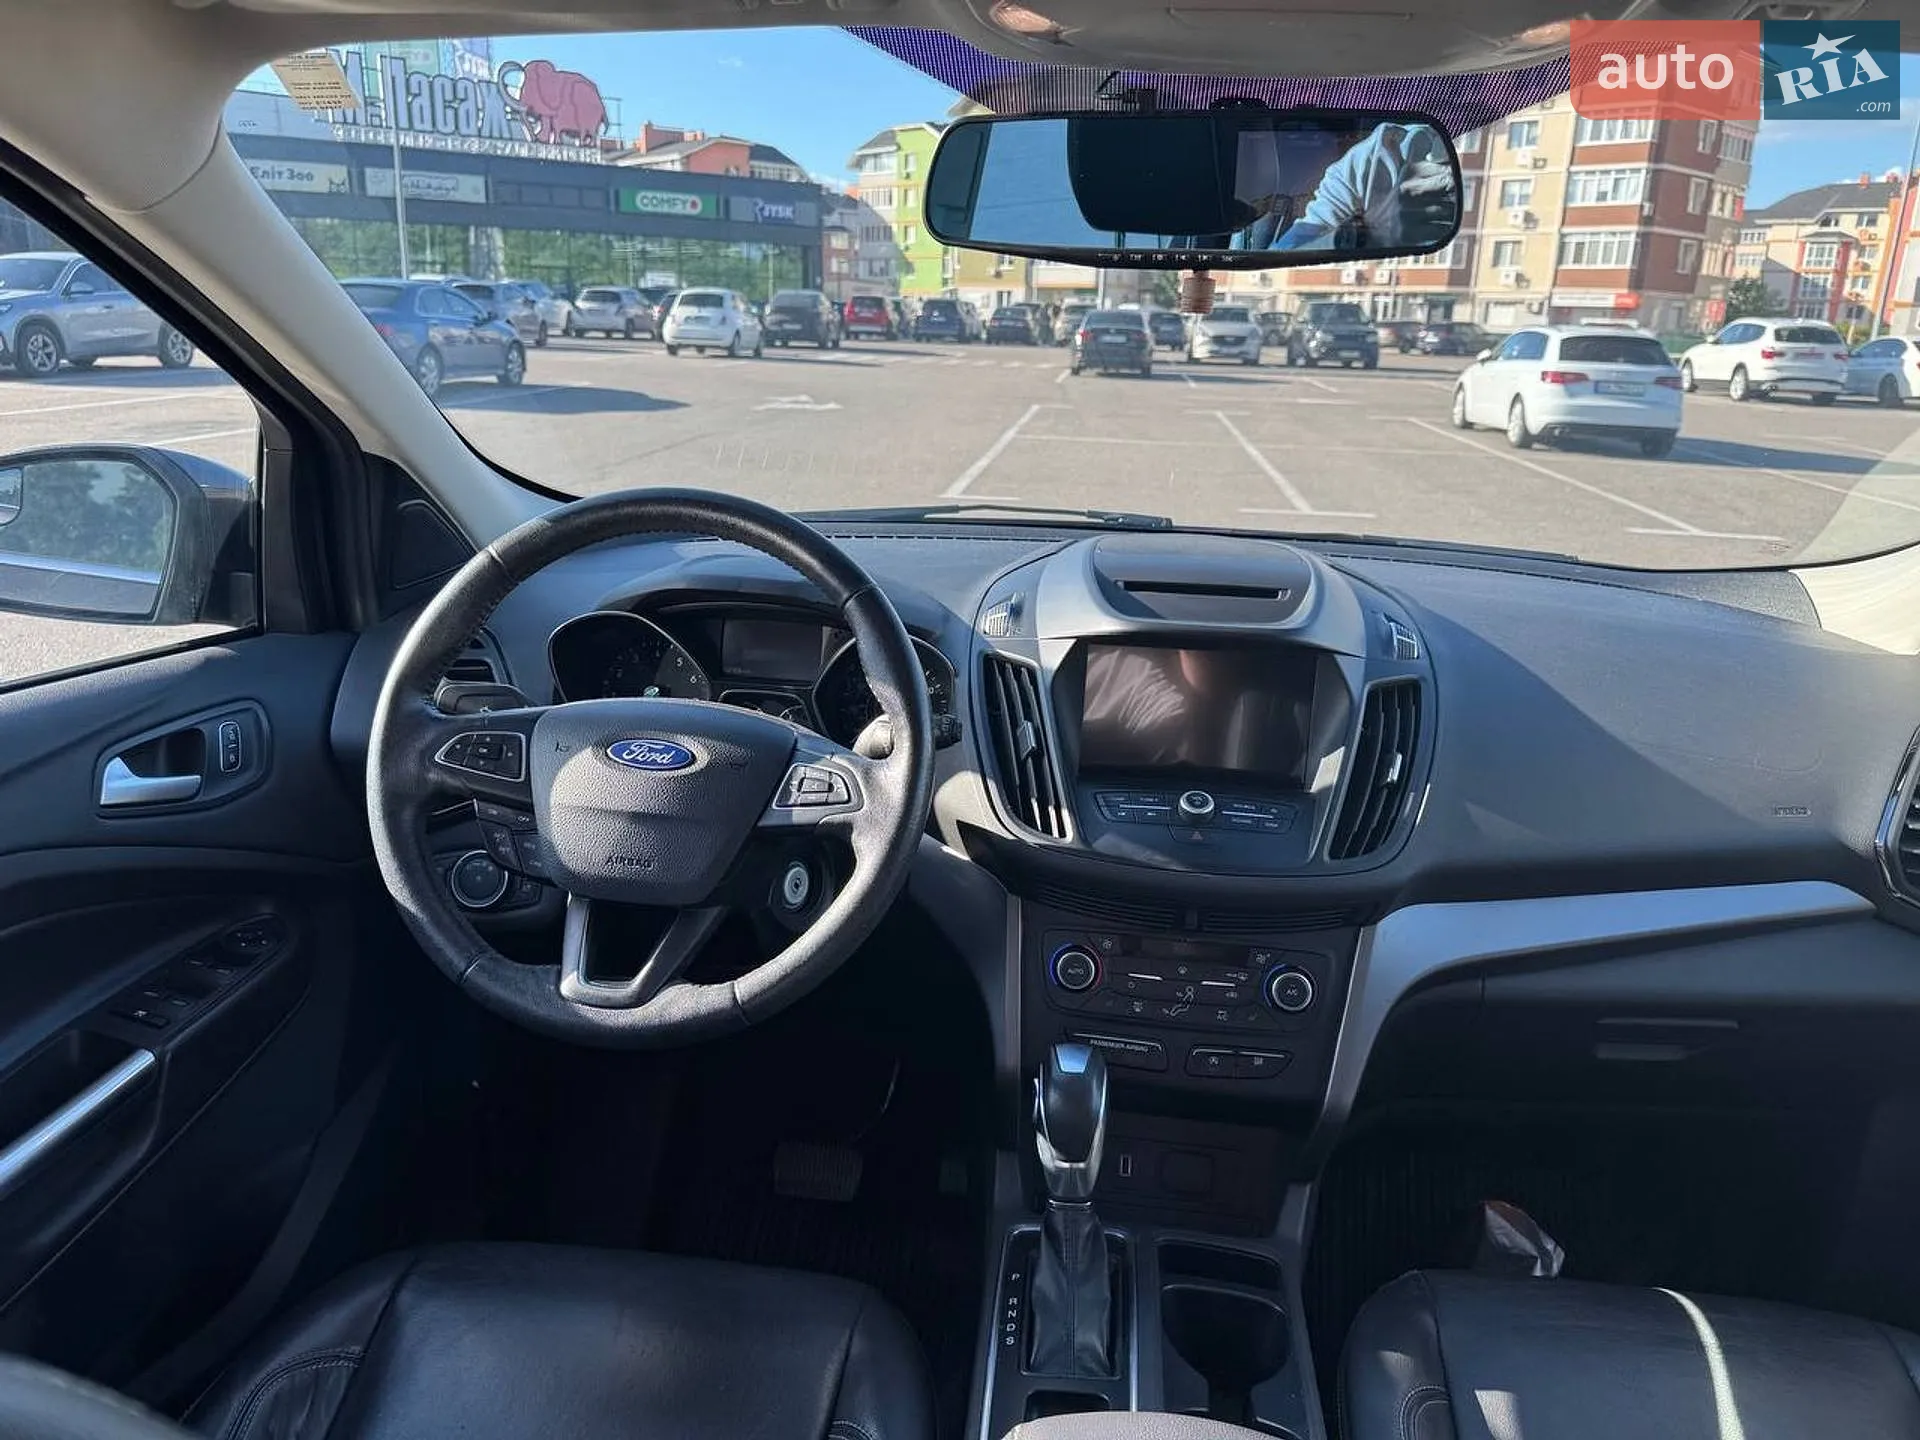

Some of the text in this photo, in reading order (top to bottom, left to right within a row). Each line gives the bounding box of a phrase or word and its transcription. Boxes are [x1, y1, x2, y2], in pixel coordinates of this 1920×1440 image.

[640, 194, 688, 212] COMFY
[762, 203, 794, 220] JYSK
[690, 675, 697, 684] 6
[623, 742, 676, 764] Ford
[605, 855, 653, 868] AIRBAG
[1008, 1309, 1017, 1318] N
